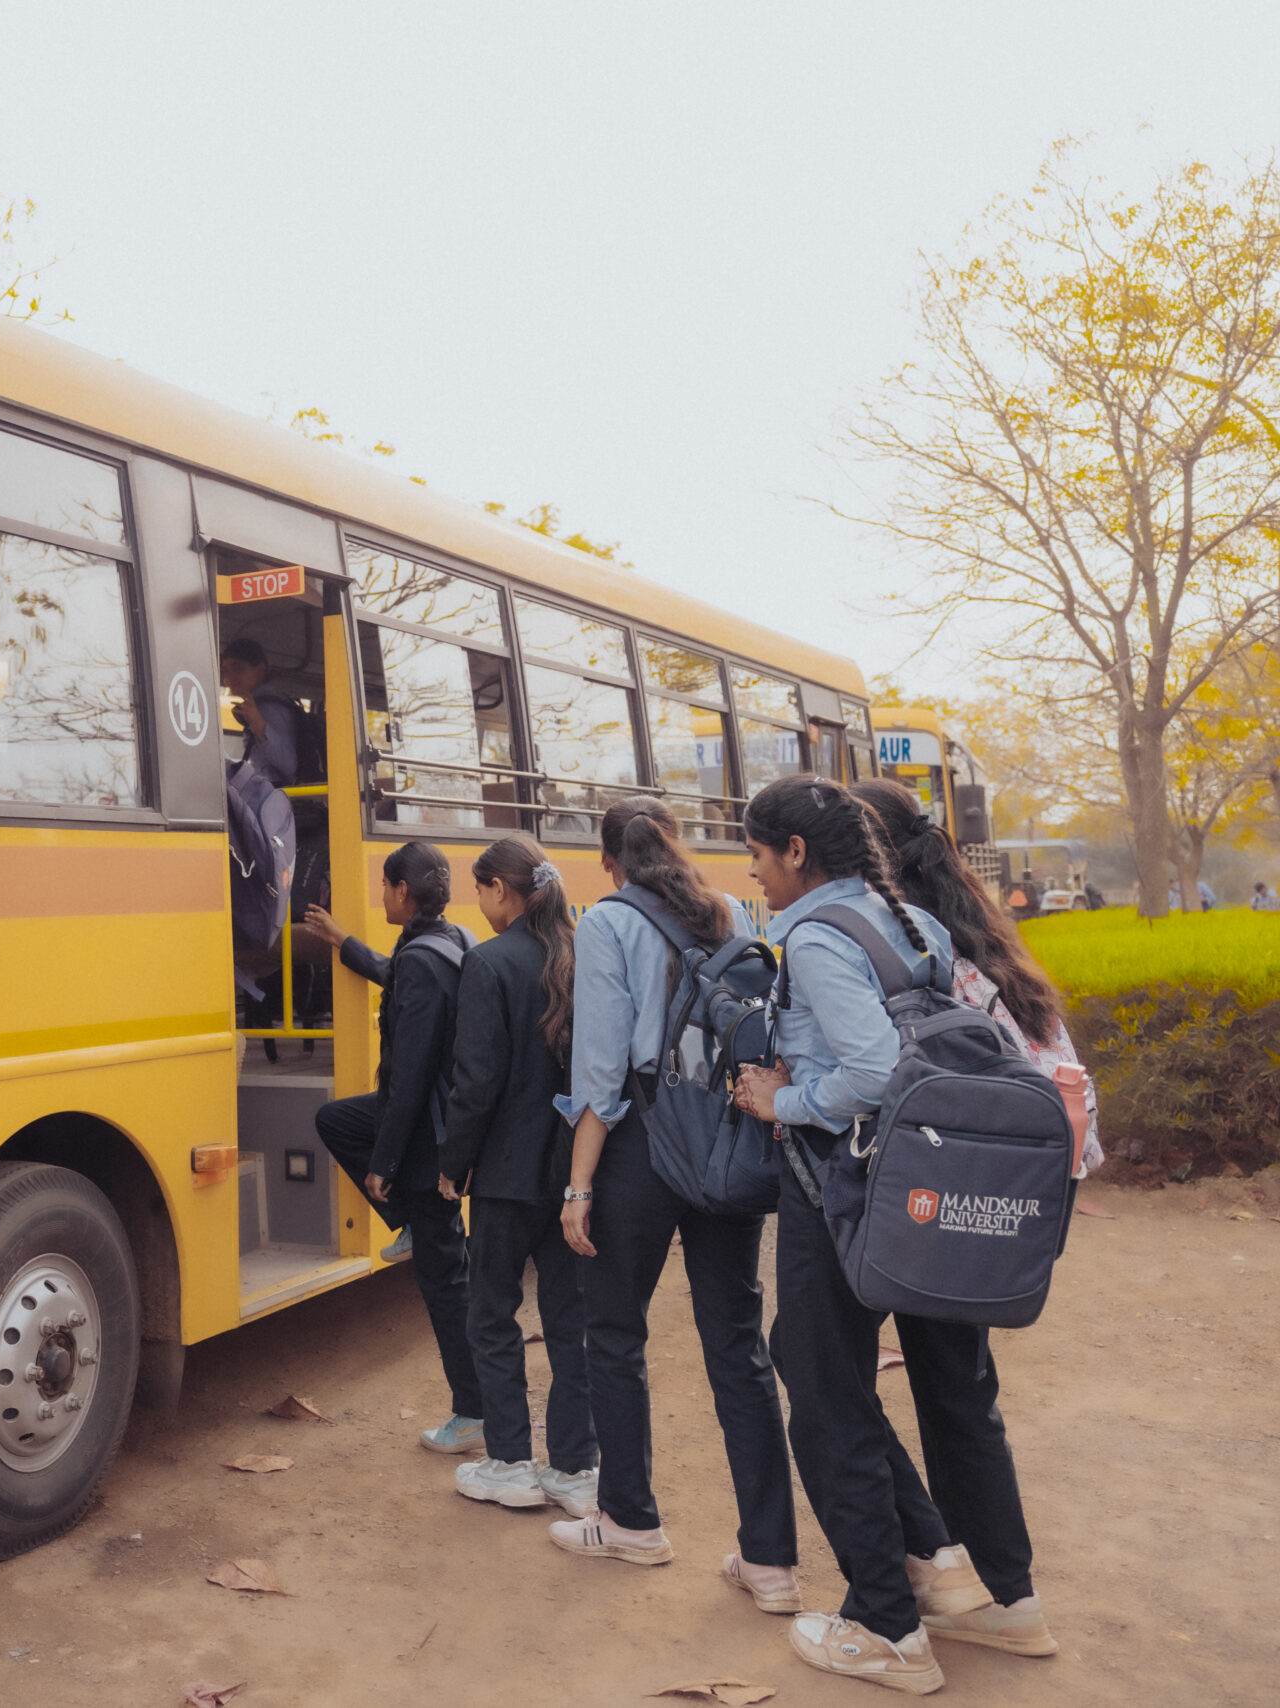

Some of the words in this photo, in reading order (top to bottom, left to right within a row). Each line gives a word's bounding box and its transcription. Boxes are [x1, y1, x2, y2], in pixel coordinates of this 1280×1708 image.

[242, 573, 288, 598] STOP
[174, 684, 202, 732] 14
[940, 1192, 1041, 1217] MANDSAUR
[939, 1209, 1023, 1230] UNIVERSITY
[939, 1222, 967, 1232] MAKING
[968, 1226, 993, 1235] FUTURE
